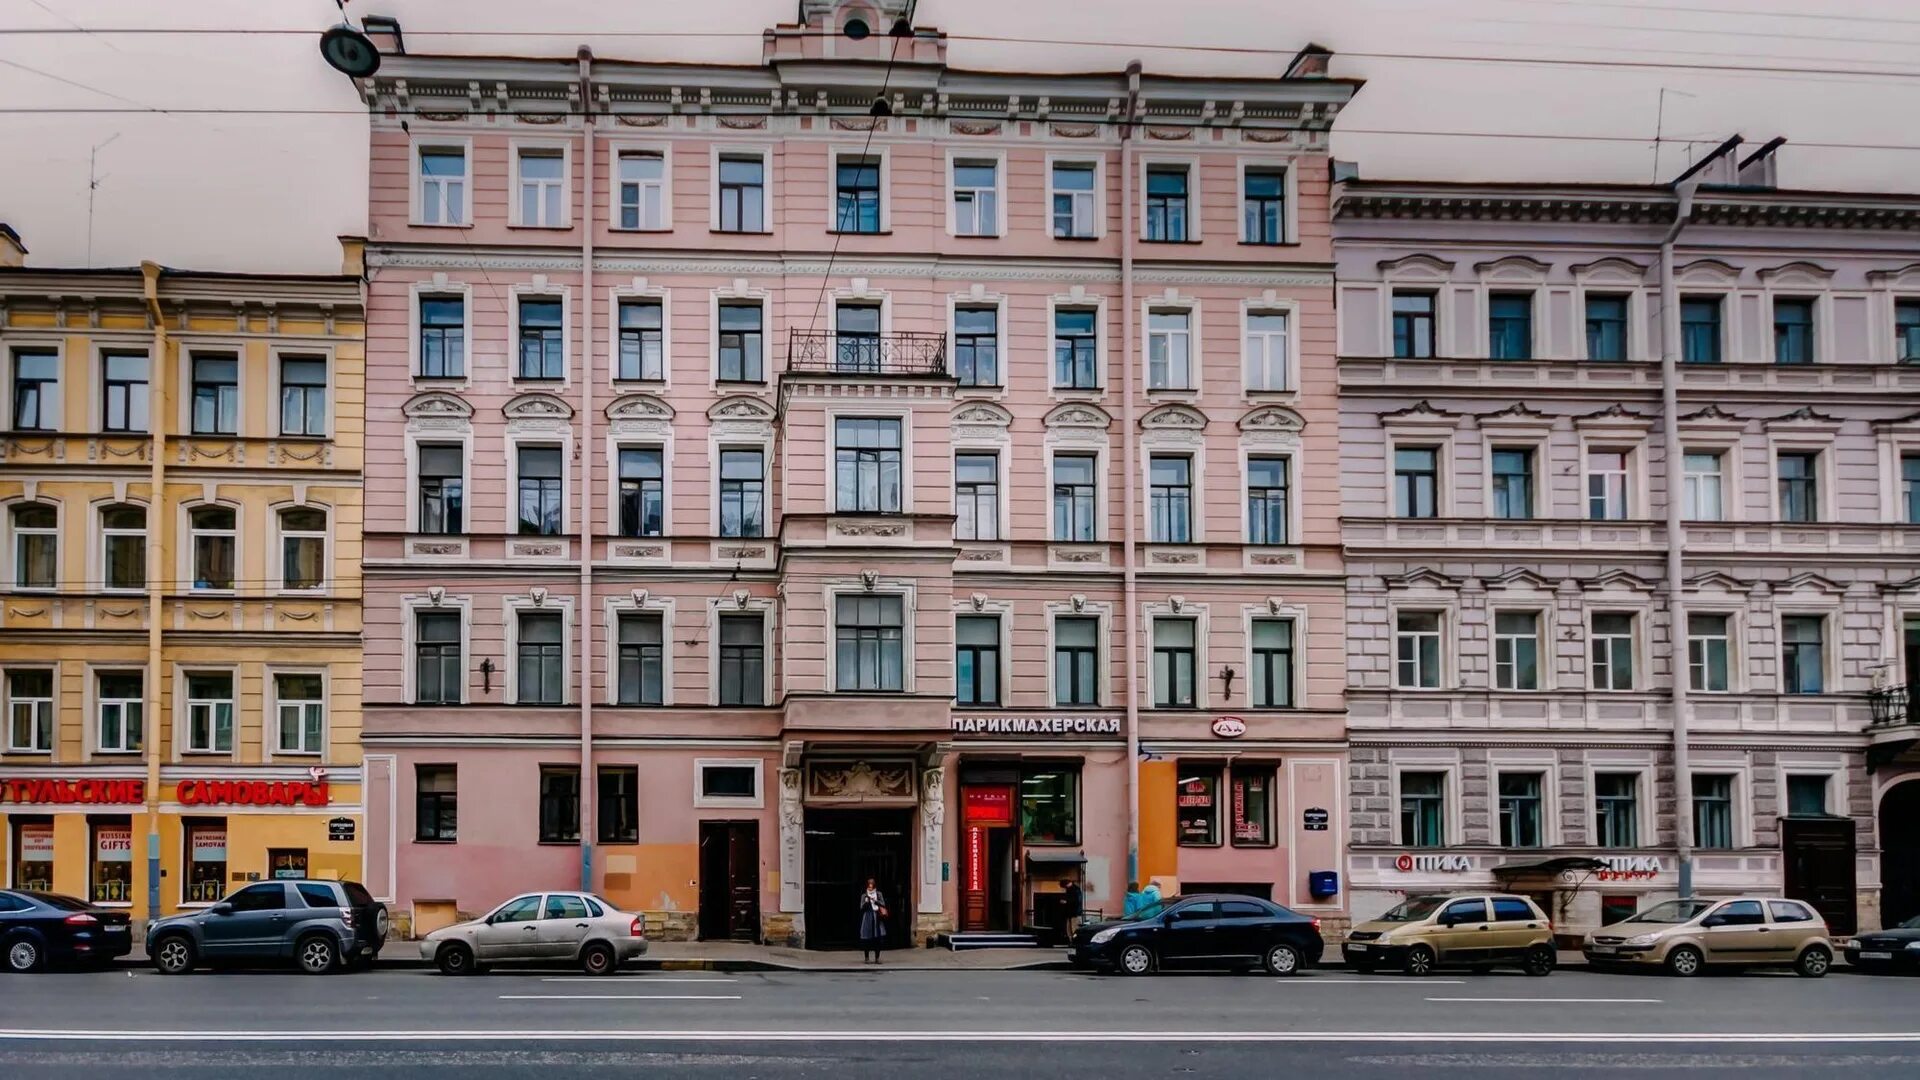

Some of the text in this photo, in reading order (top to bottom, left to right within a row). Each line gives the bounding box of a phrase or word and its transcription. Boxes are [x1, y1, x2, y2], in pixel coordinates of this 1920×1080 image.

[952, 718, 1121, 733] ПАРИКМАХЕРСКАЯ
[8, 779, 144, 804] ТУЛЬСКИЕ
[177, 780, 329, 806] САМОВАРЫ
[100, 841, 131, 850] GIFTS
[1395, 854, 1472, 872] ОПТИКА
